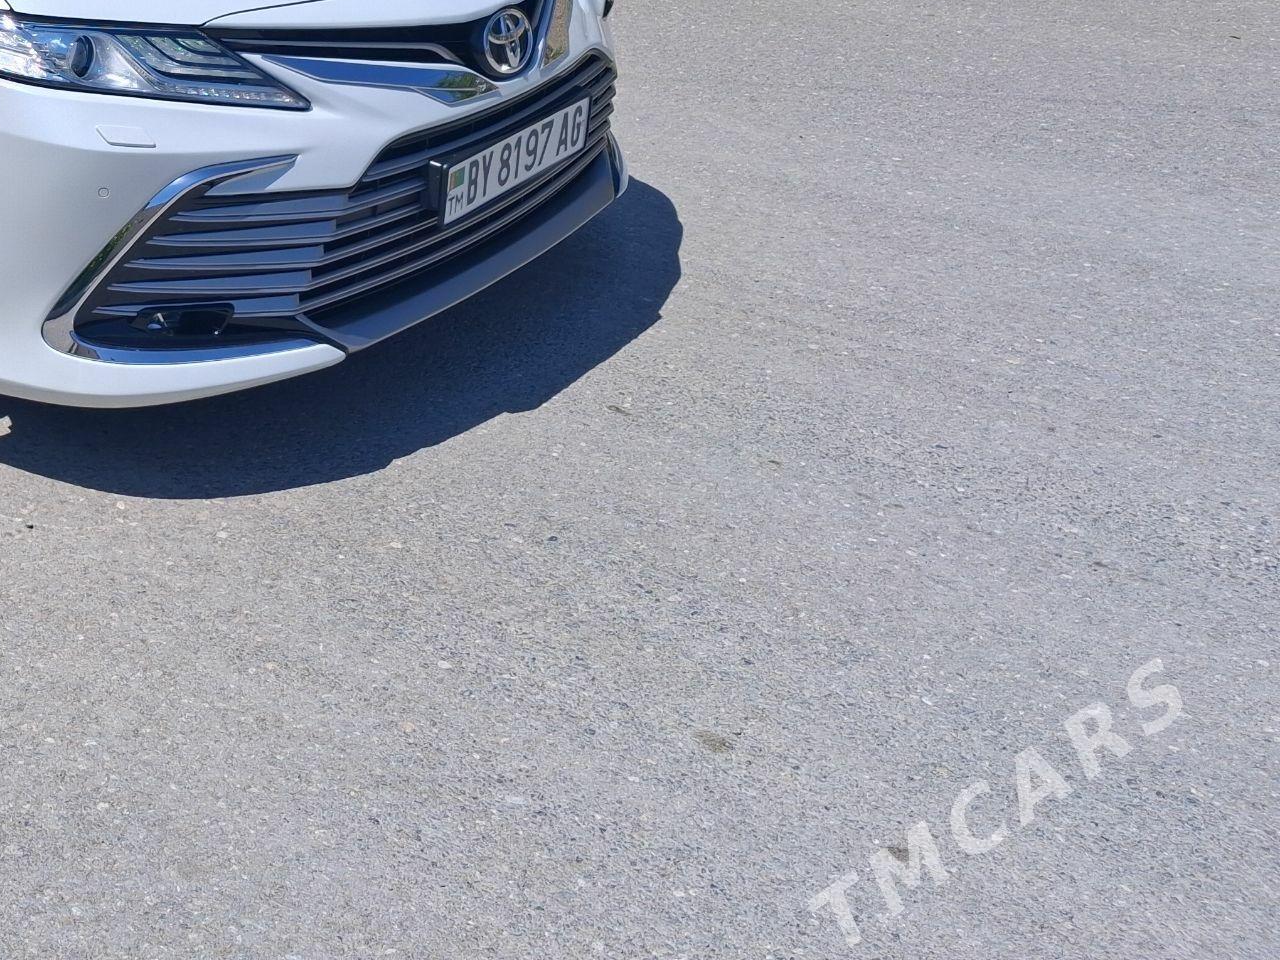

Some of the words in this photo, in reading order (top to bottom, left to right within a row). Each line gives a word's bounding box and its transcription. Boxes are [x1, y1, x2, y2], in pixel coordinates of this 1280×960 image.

[466, 150, 494, 206] BY
[497, 119, 555, 187] 8197
[556, 105, 584, 156] AG
[447, 191, 464, 216] TM
